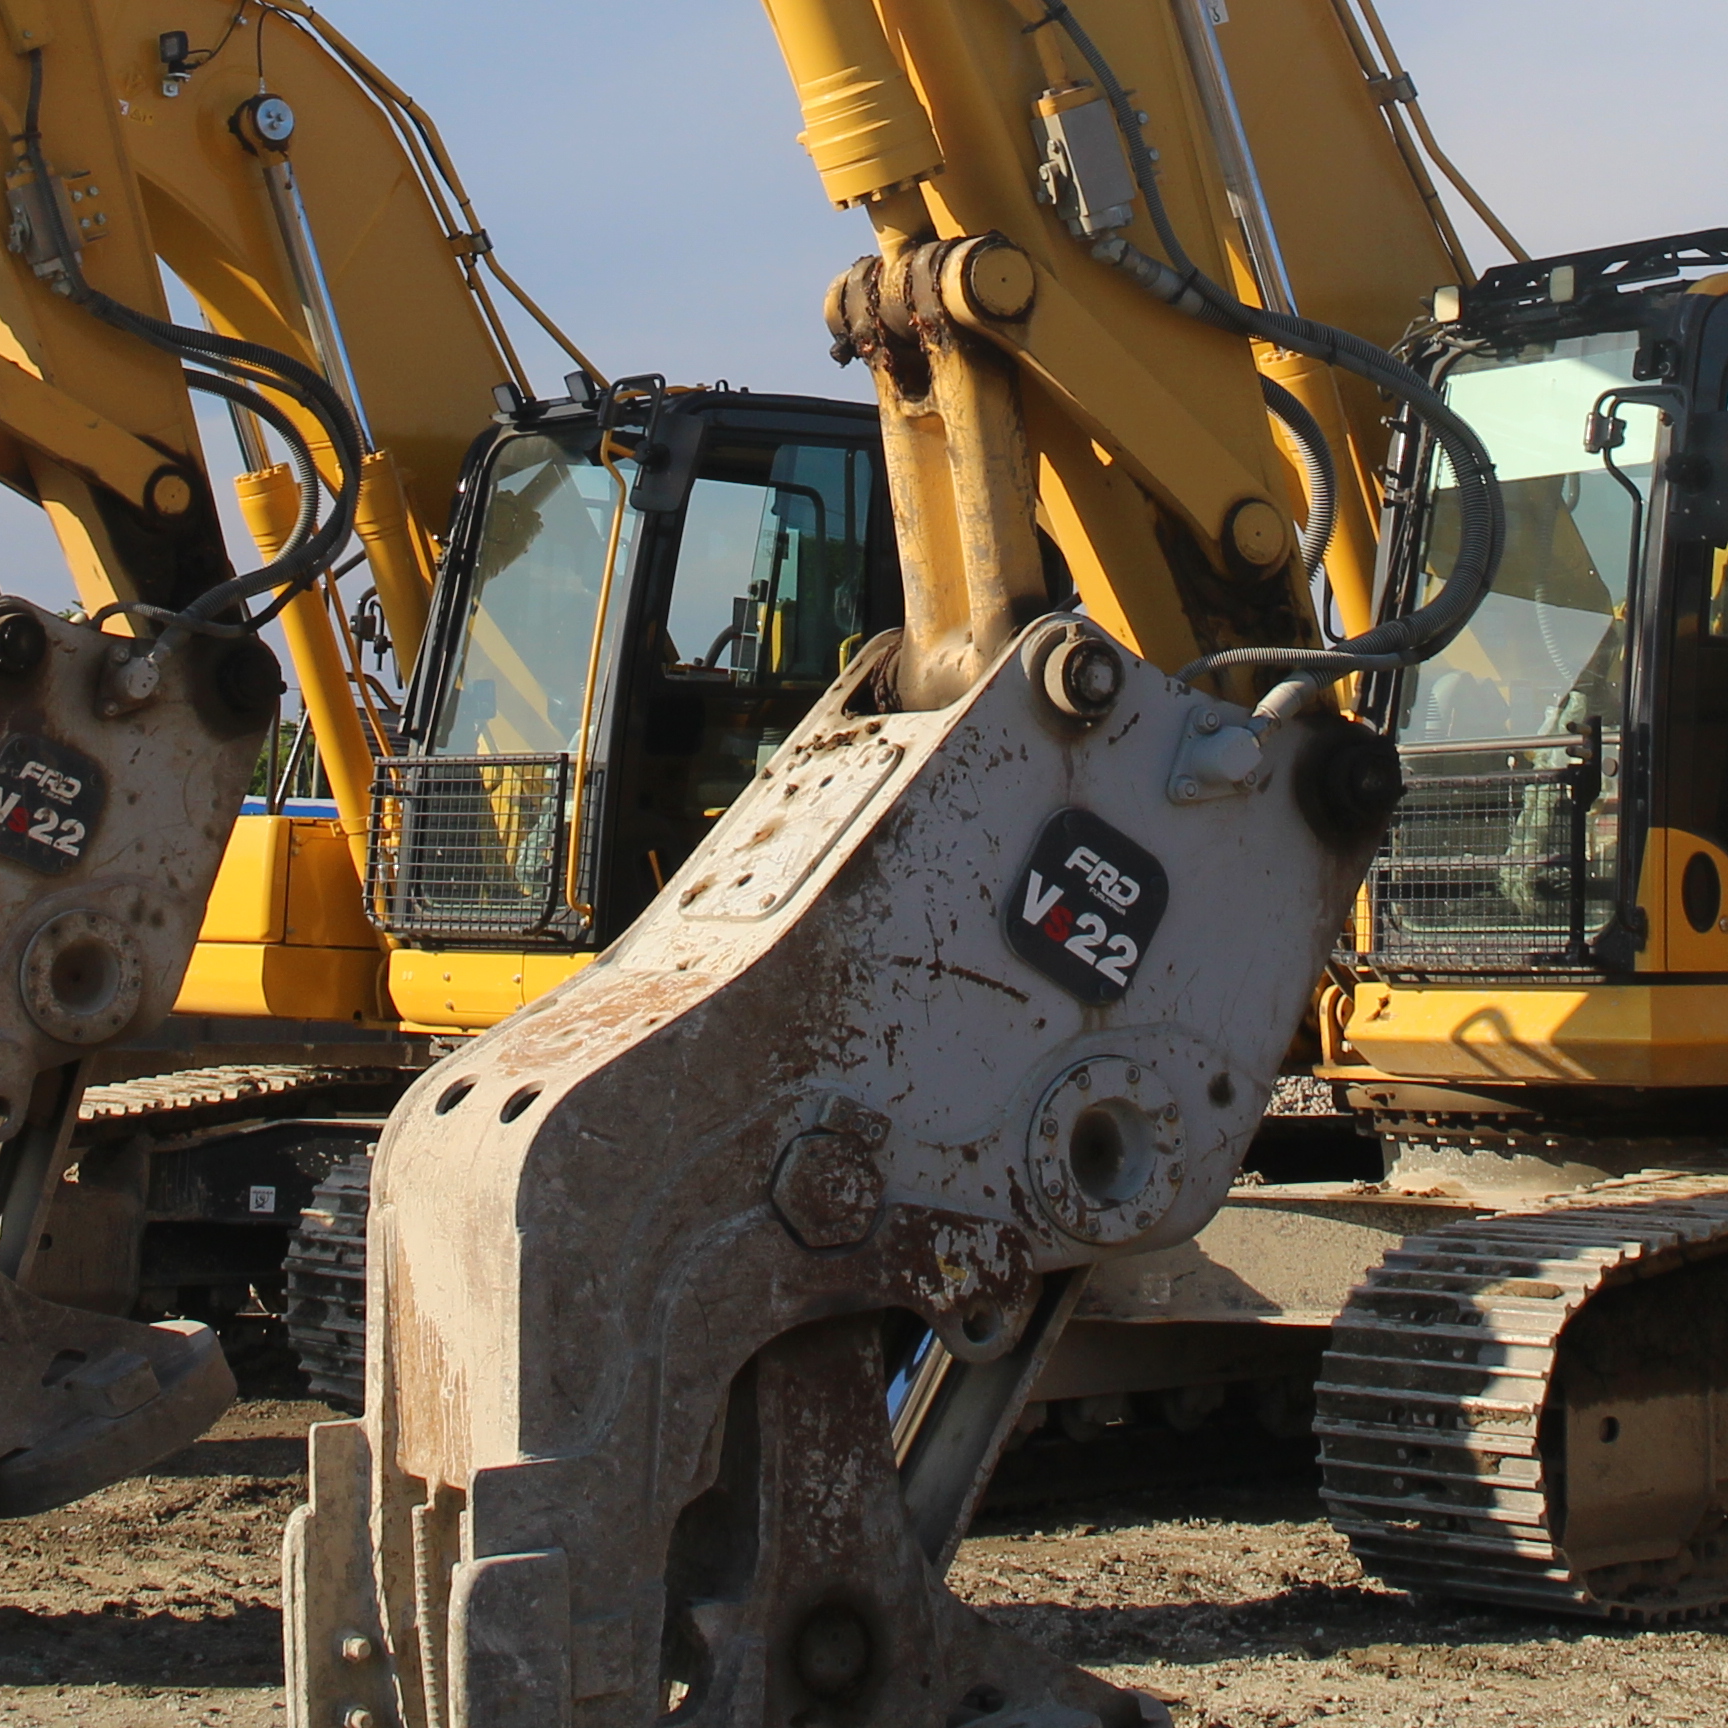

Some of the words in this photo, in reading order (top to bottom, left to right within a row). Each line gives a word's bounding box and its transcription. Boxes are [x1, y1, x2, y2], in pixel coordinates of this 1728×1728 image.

[19, 760, 82, 799] FRD
[1064, 846, 1141, 906] FRD
[1022, 869, 1138, 987] VS22
